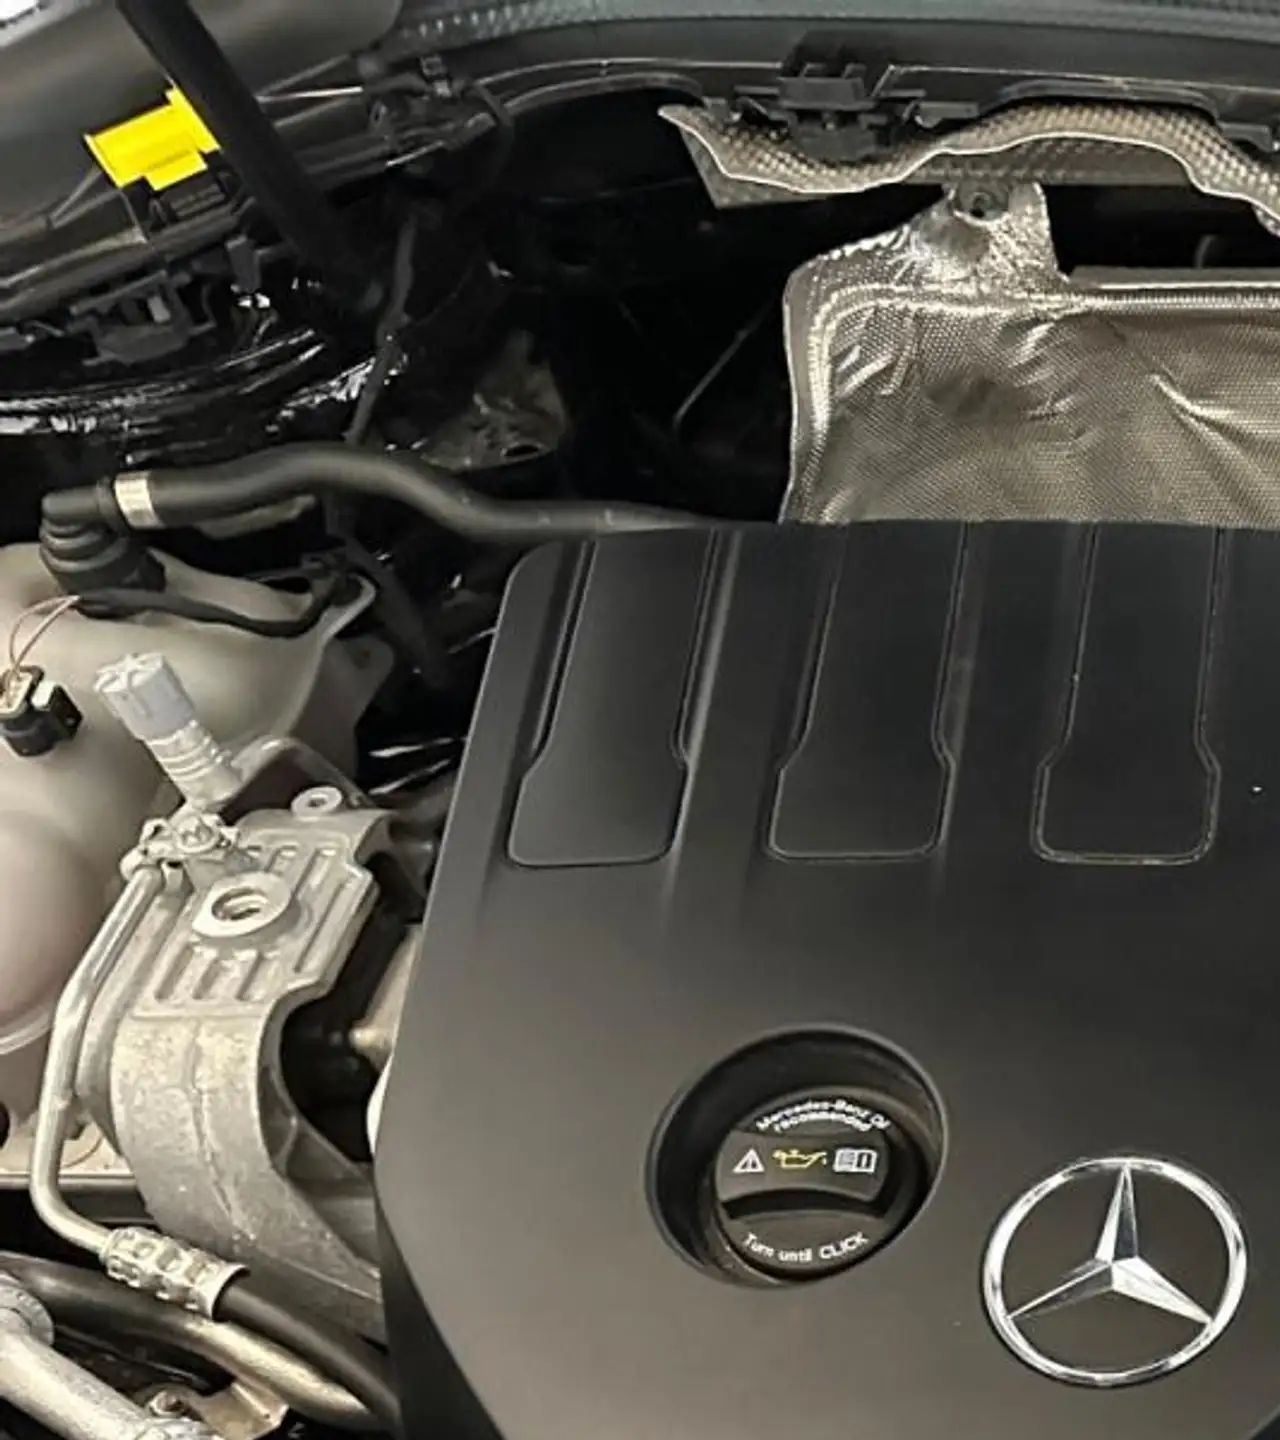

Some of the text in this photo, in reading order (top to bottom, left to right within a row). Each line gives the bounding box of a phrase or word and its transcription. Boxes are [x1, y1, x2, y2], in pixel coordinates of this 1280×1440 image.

[755, 1099, 874, 1132] Mercedes-Benz
[743, 1231, 870, 1263] Turn until CLICK
